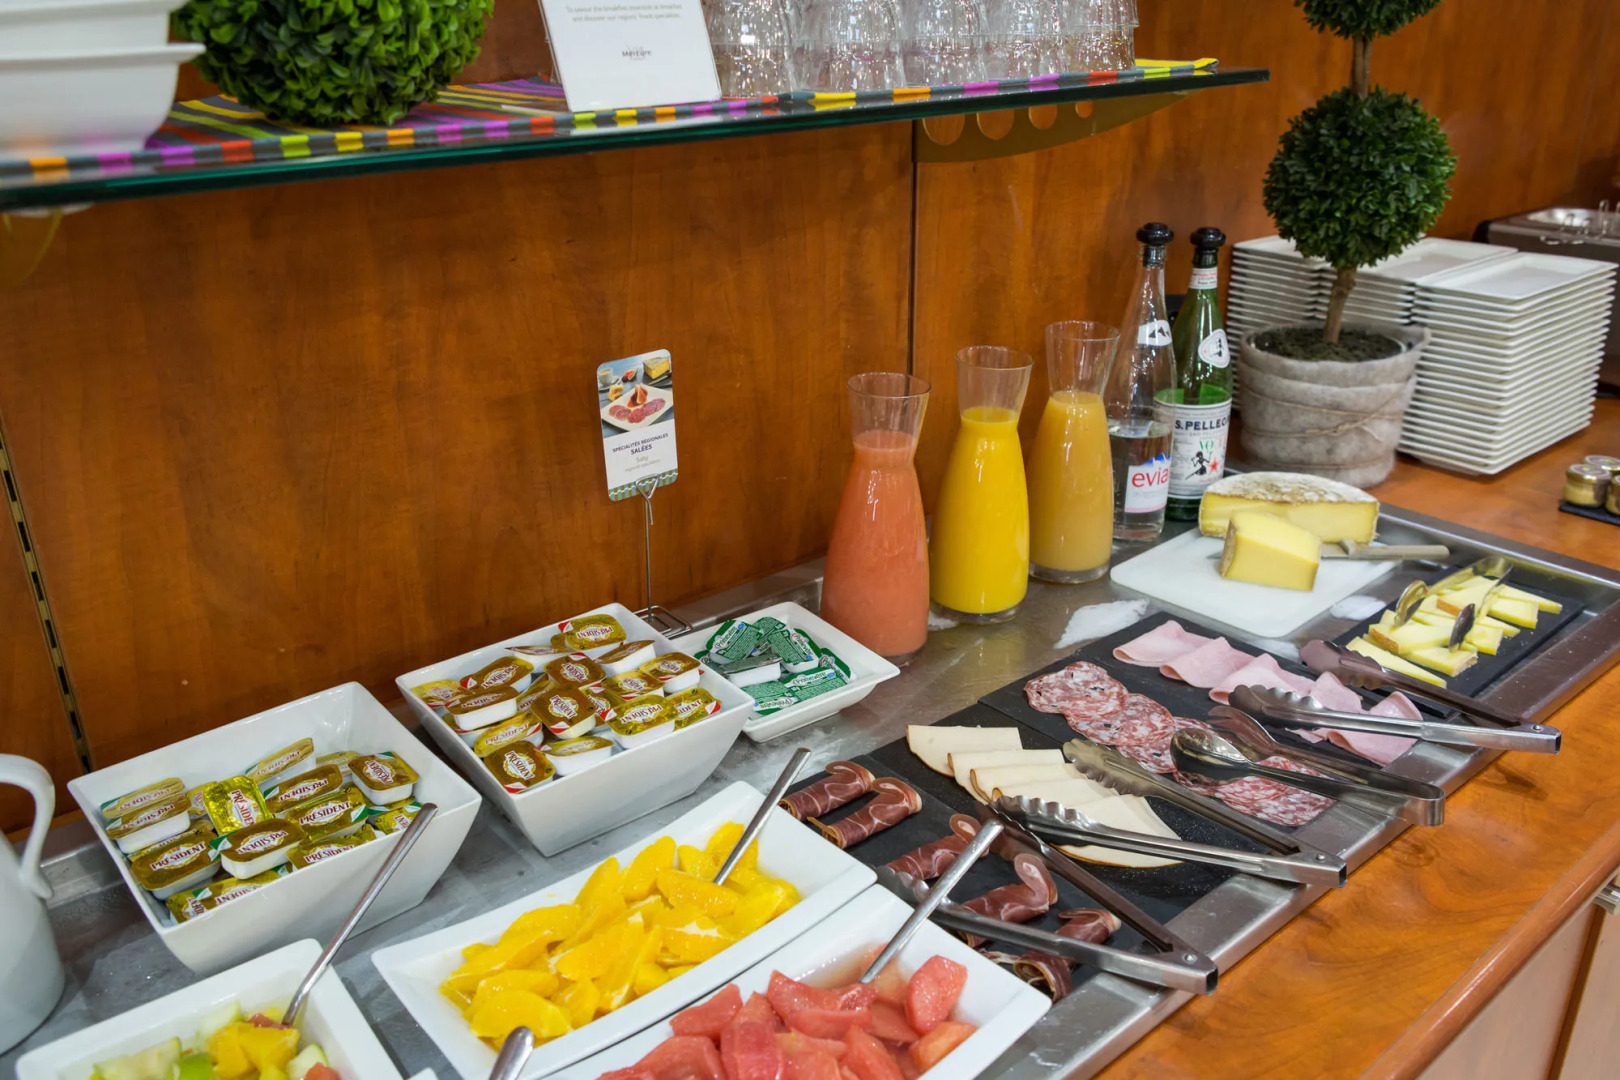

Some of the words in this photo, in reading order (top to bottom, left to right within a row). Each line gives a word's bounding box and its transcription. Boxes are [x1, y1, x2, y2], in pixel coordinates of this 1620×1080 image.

[612, 441, 640, 453] SPÉCIALITÉS
[641, 433, 669, 445] RÉGIONALES
[630, 444, 653, 455] SALÉES
[1131, 467, 1171, 488] evia
